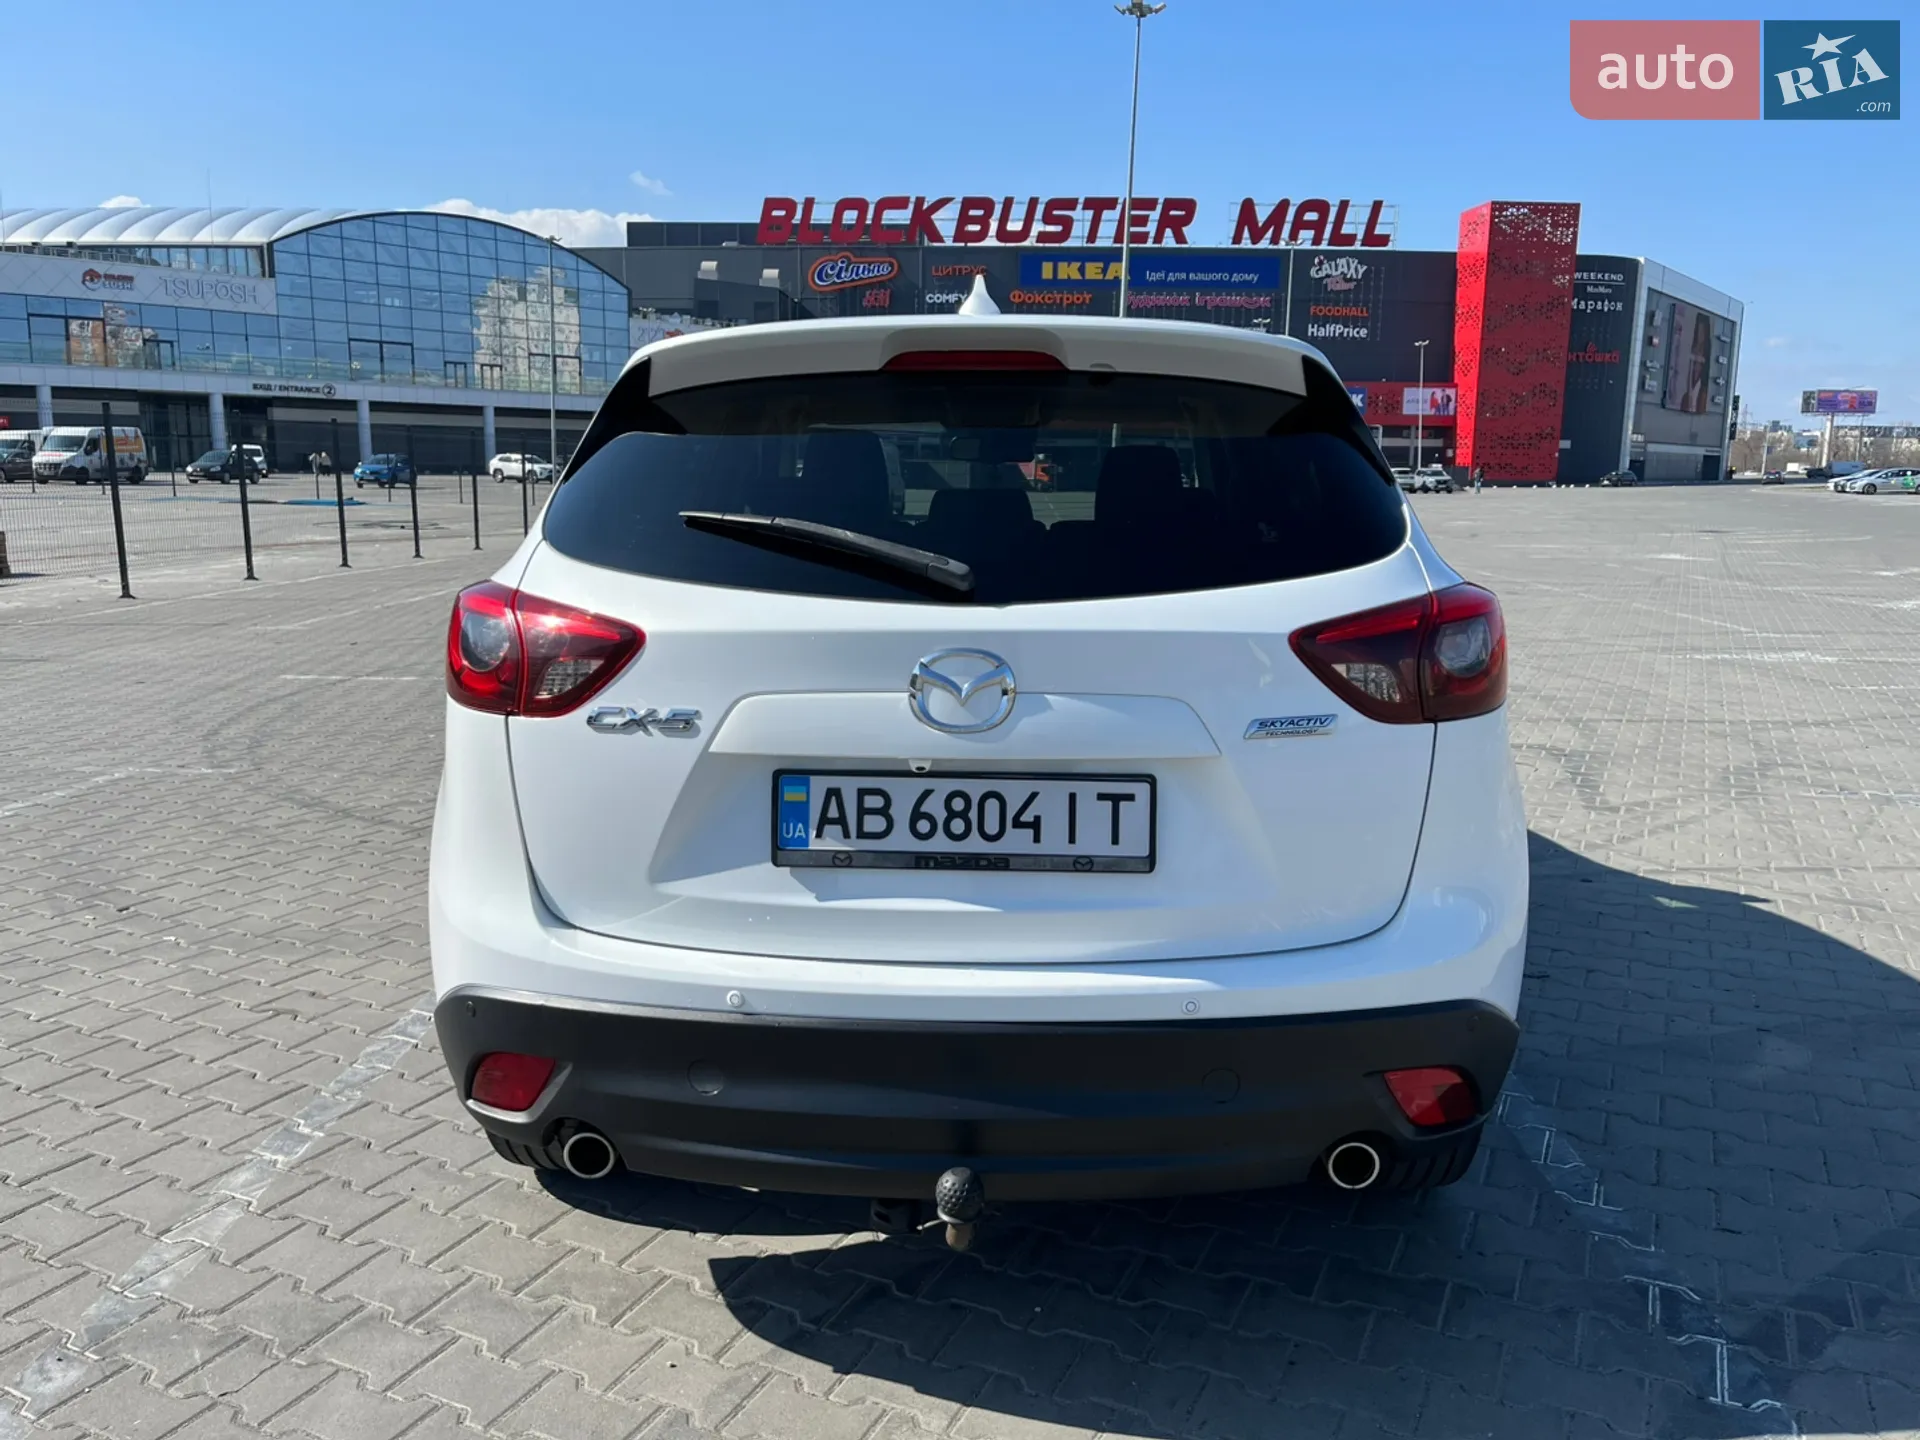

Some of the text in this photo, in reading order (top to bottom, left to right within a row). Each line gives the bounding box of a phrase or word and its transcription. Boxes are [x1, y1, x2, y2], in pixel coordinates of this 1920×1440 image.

[756, 196, 1392, 248] BLOCKBUSTER MALL
[814, 258, 892, 286] Сільпо
[931, 265, 988, 277] ЦИТРУС
[1041, 261, 1131, 280] IKEA
[1310, 256, 1368, 279] GALAXY
[1146, 270, 1259, 284] Ідеї для вашого дому
[1573, 271, 1624, 281] WEEKEND
[926, 293, 969, 304] COMFY
[1009, 289, 1093, 306] Фокстрот
[1310, 305, 1369, 317] FOODHALL
[1307, 323, 1368, 338] HalfPrice
[586, 706, 701, 737] CX-5
[1257, 717, 1329, 729] SKYACTIV
[814, 787, 1136, 846] AB 6804 IT
[782, 822, 806, 839] UA
[914, 856, 1010, 869] mazda
